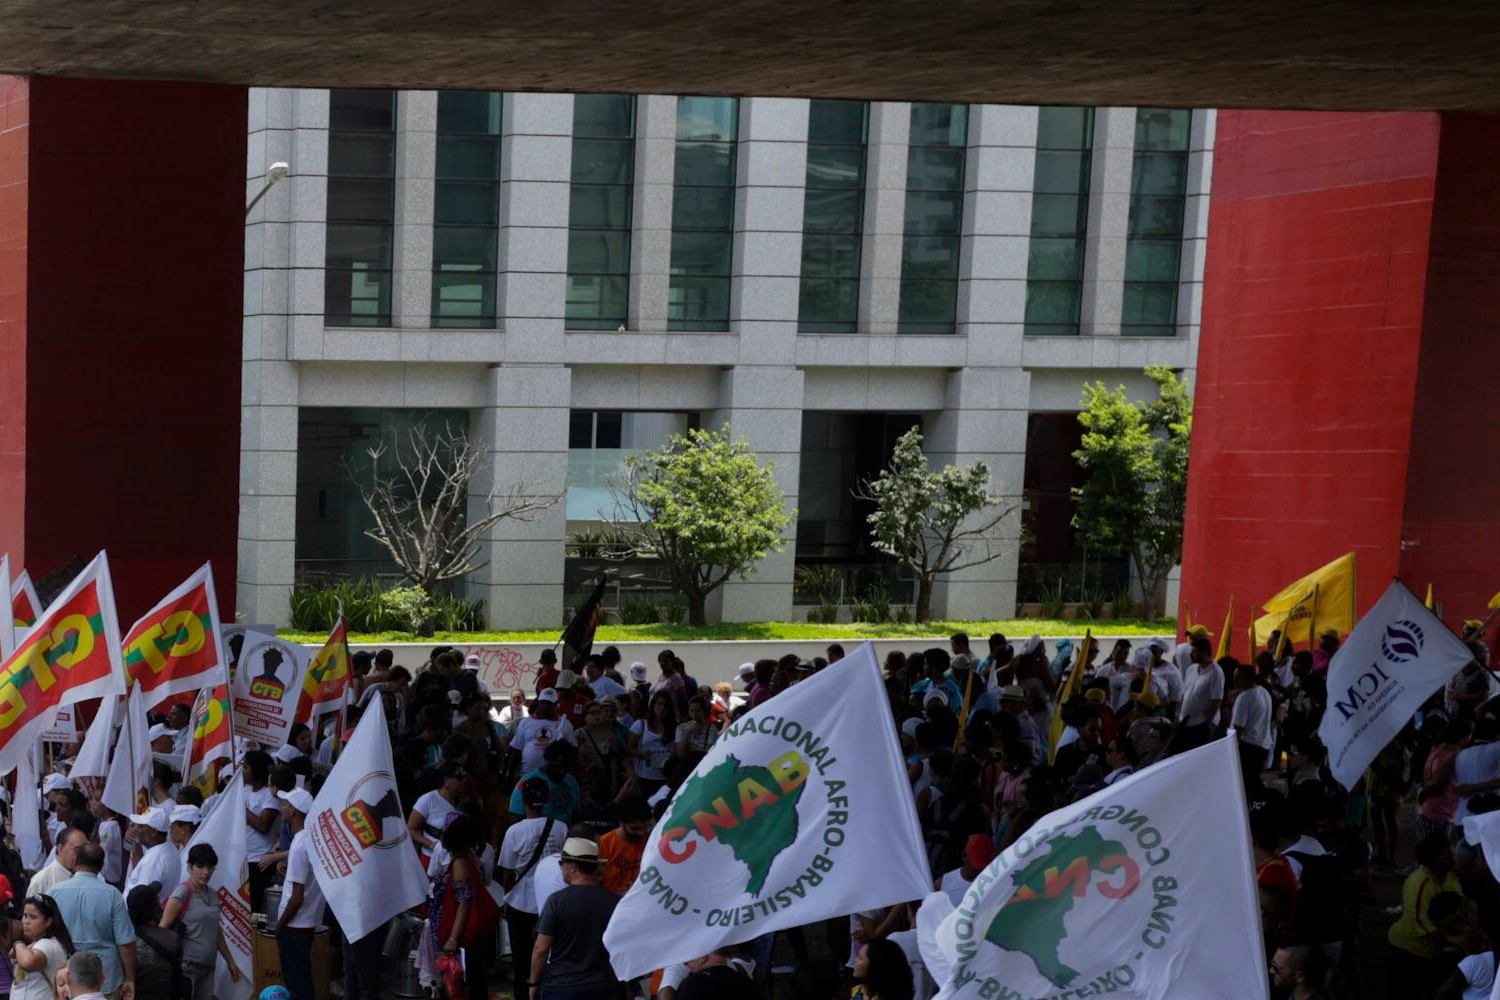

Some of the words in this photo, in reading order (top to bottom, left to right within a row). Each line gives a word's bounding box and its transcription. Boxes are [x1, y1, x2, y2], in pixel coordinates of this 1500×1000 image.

[251, 682, 284, 700] CTB
[723, 716, 837, 776] NACIONAL
[347, 807, 377, 844] CTB
[658, 751, 811, 865] CNAB
[706, 780, 849, 928] AFRO-BRASILEIRO
[639, 865, 688, 915] CNAB
